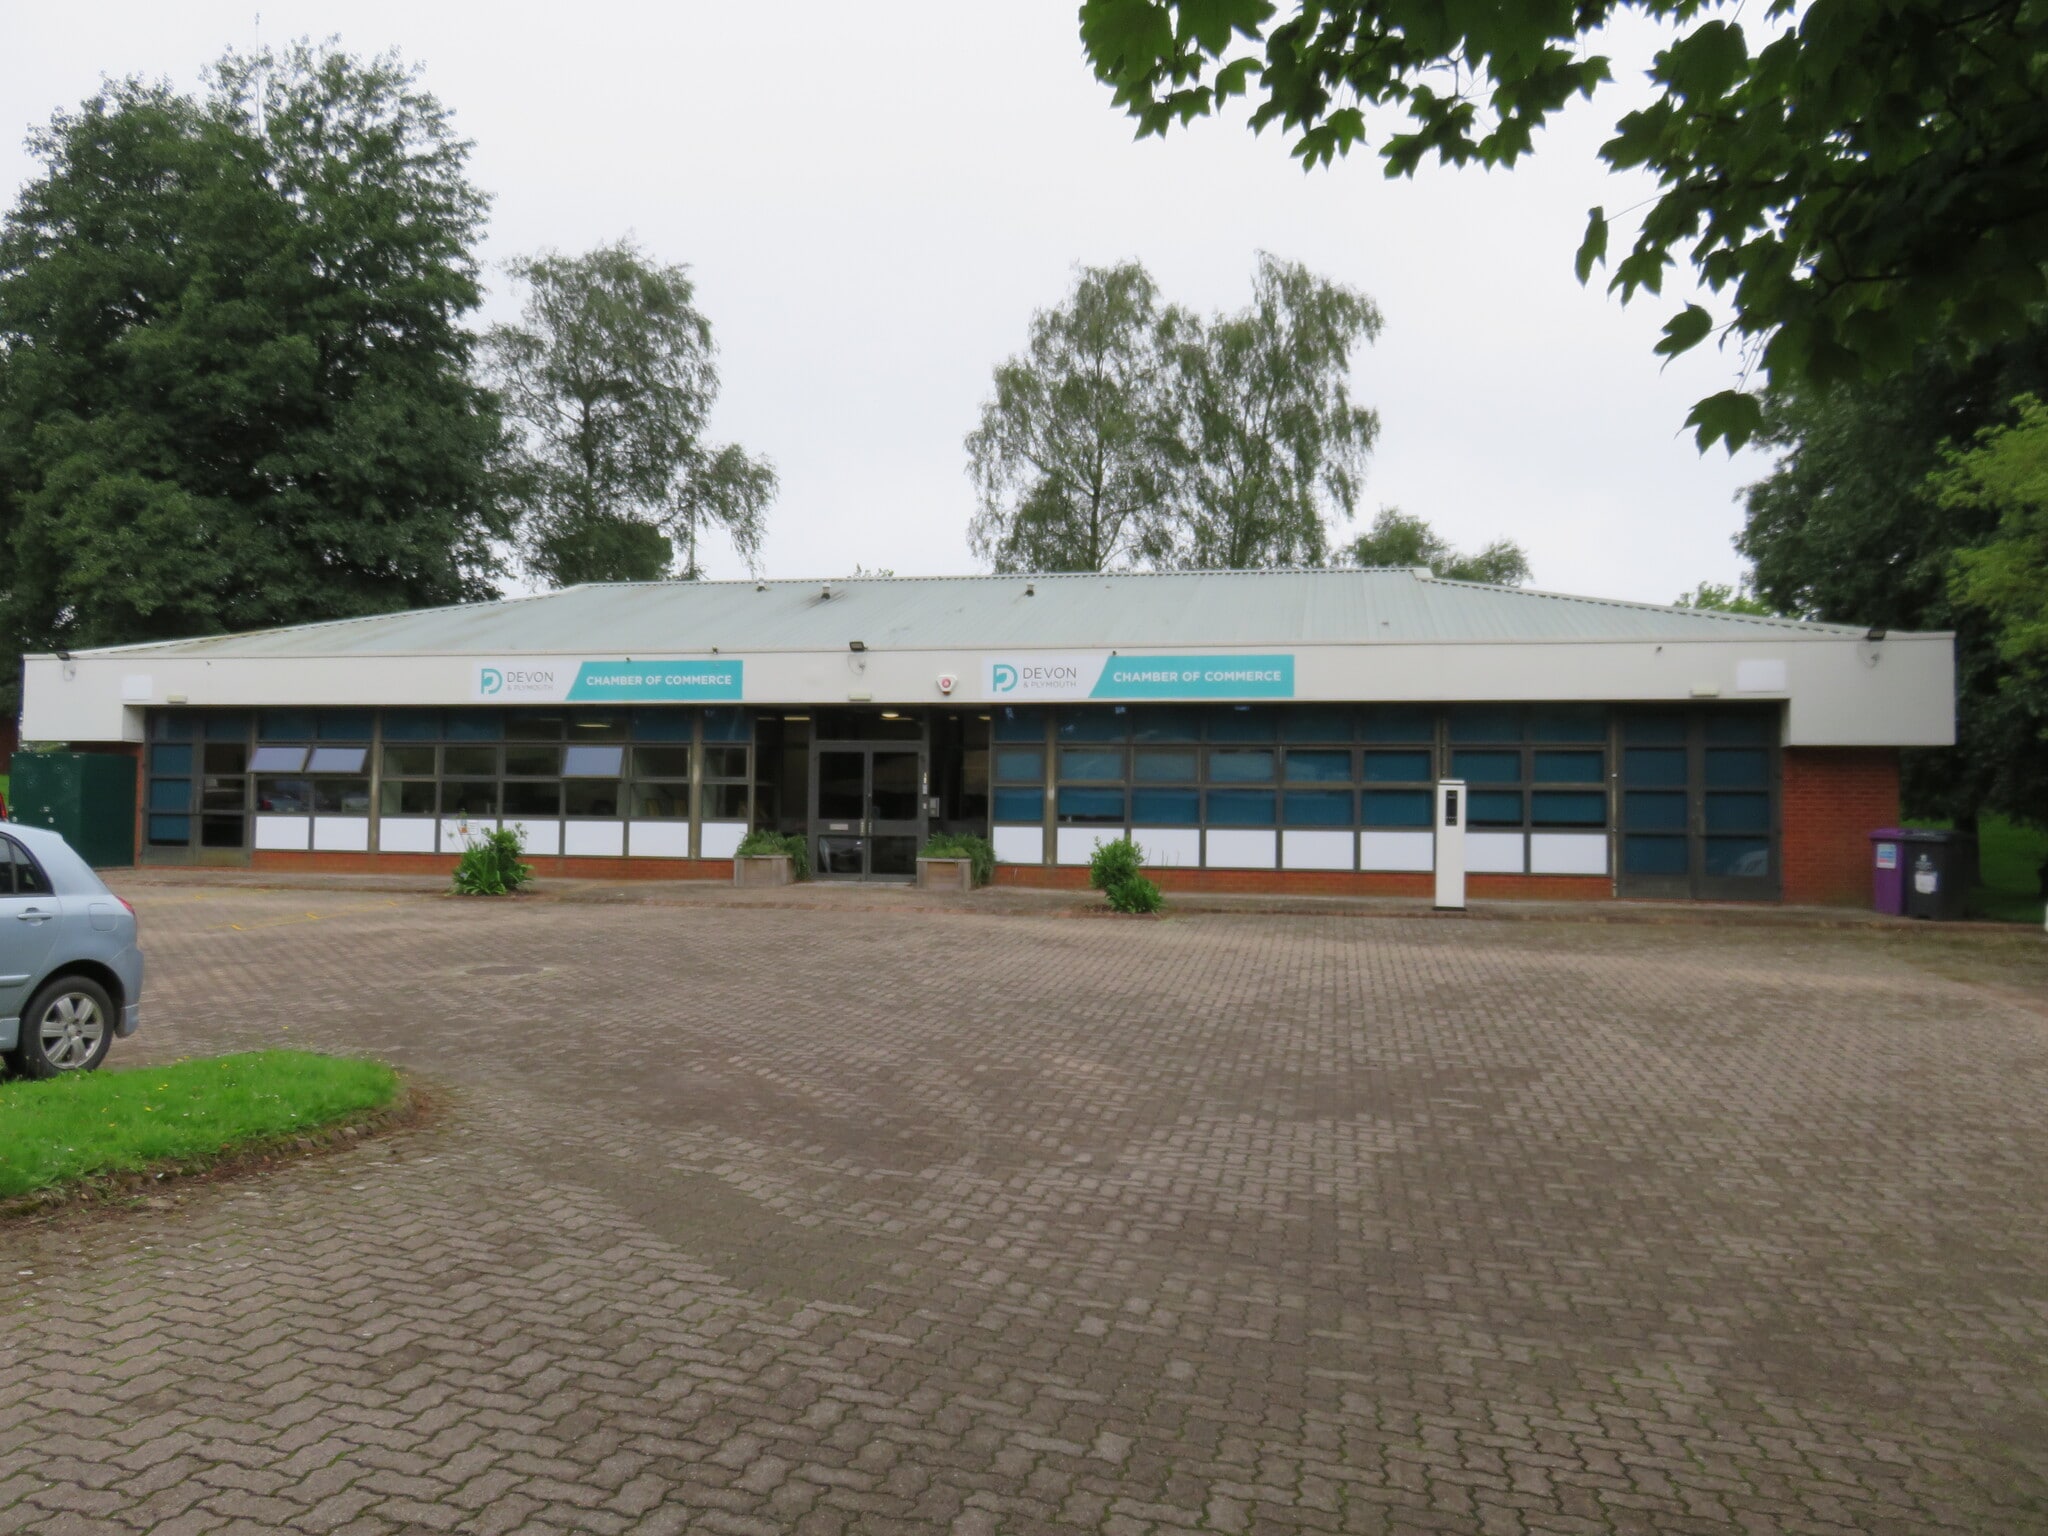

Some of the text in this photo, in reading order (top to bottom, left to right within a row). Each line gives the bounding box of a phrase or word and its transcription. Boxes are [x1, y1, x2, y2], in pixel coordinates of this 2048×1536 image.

[507, 671, 554, 683] DEVON
[1023, 667, 1077, 680] DEVON
[1113, 670, 1282, 683] CHAMBER OF COMMERCE
[586, 674, 732, 686] CHAMBER OF COMMERCE
[1031, 681, 1077, 689] PLYMOUTH
